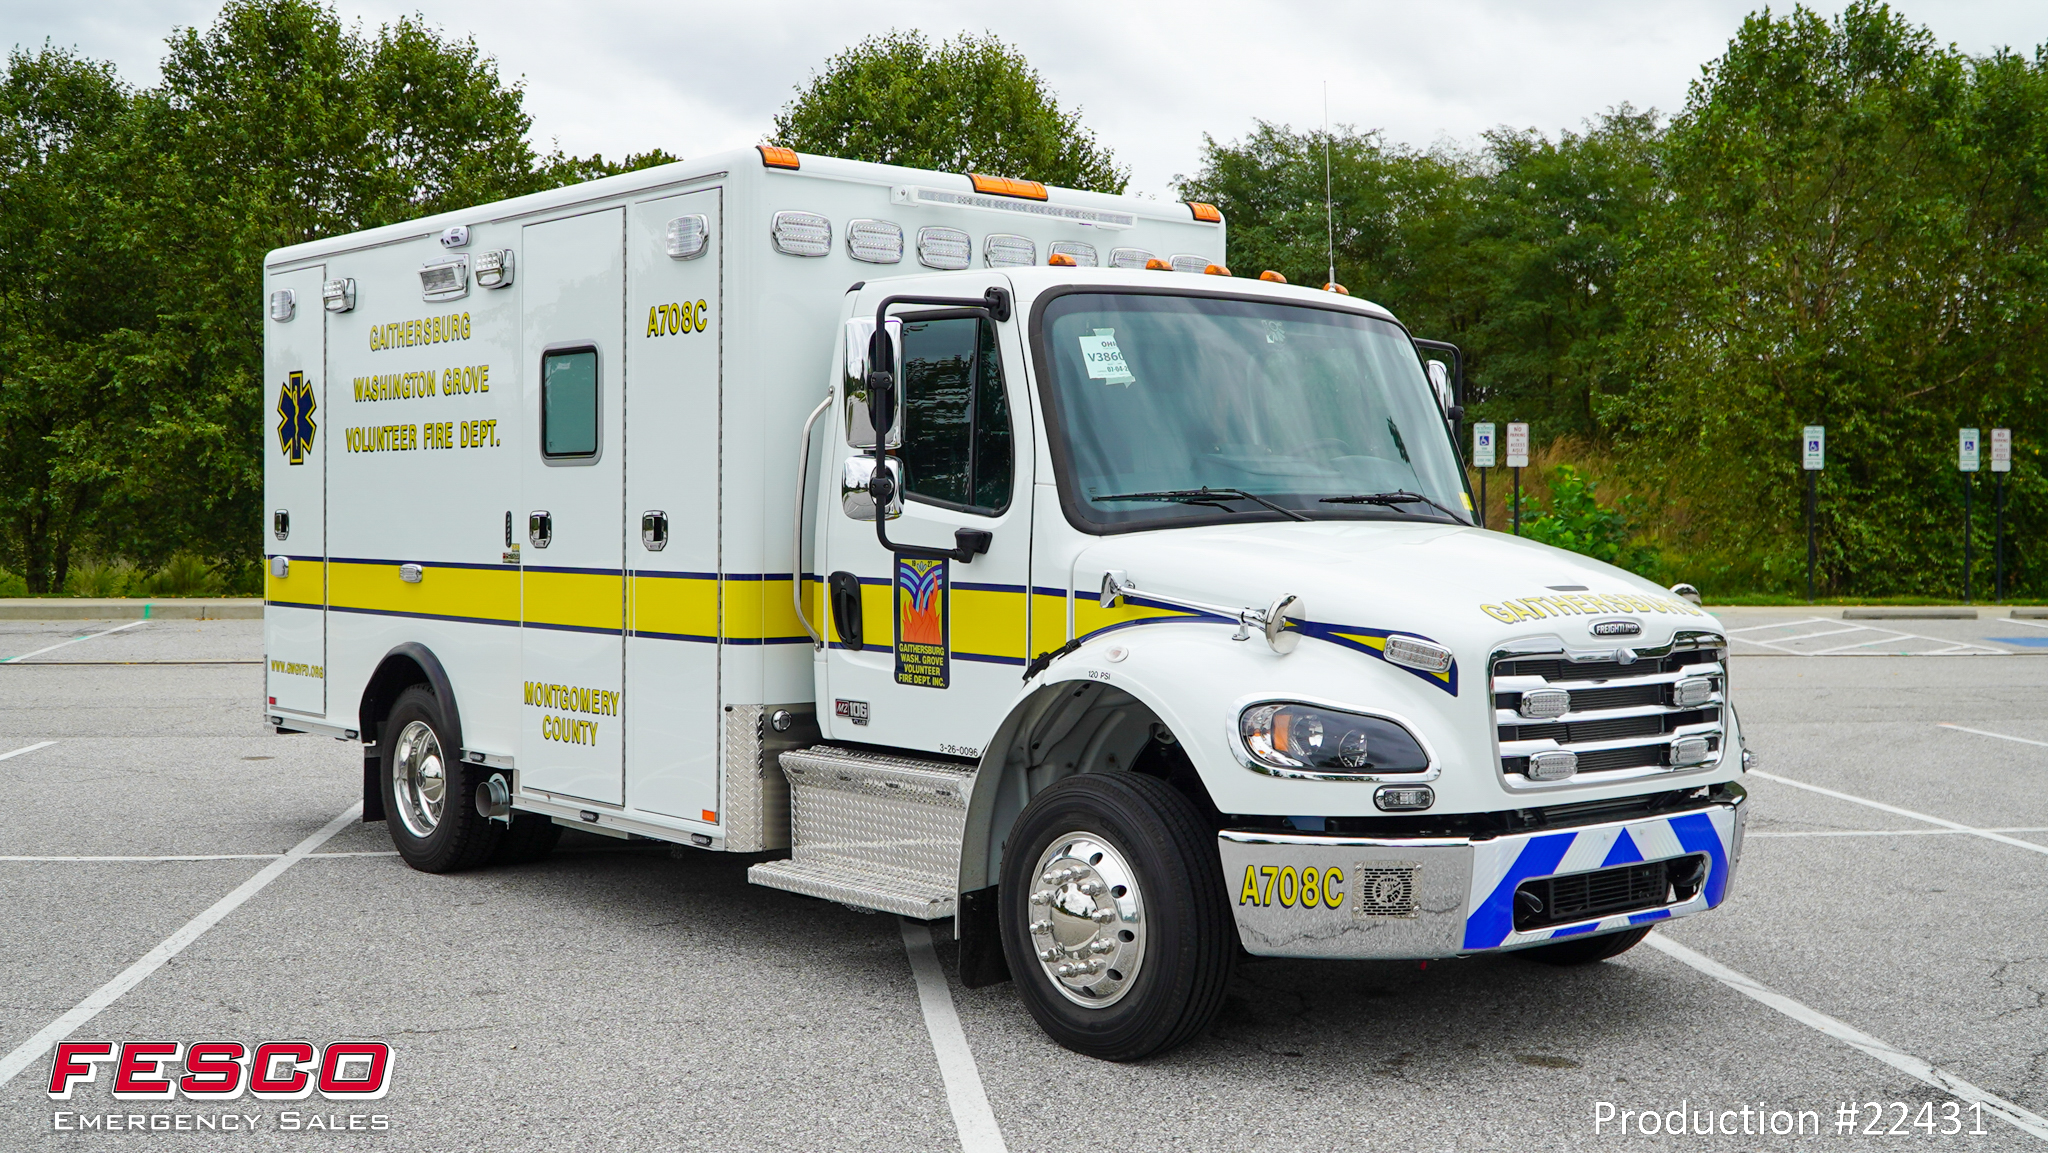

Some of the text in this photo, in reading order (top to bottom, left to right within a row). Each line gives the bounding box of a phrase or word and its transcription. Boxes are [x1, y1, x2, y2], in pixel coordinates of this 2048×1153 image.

[369, 312, 471, 352] GAITHERSBURG
[646, 298, 708, 338] A708C
[353, 365, 489, 402] WASHINGTON GROVE
[345, 419, 501, 453] VOLUNTEER FIRE DEPT.
[1479, 593, 1704, 625] GAITHERSBURG
[899, 643, 945, 655] GAITHERSBURG
[900, 653, 944, 666] WASH. GROVE
[898, 673, 913, 683] FIRE
[932, 676, 946, 687] INC.
[904, 664, 940, 675] VOLUNTEER
[1088, 670, 1111, 681] 120 PSI
[524, 681, 620, 717] MONTGOMERY
[850, 701, 868, 718] 106
[542, 714, 598, 747] COUNTY
[939, 743, 979, 757] 3-26-0096
[1239, 864, 1344, 910] A708C
